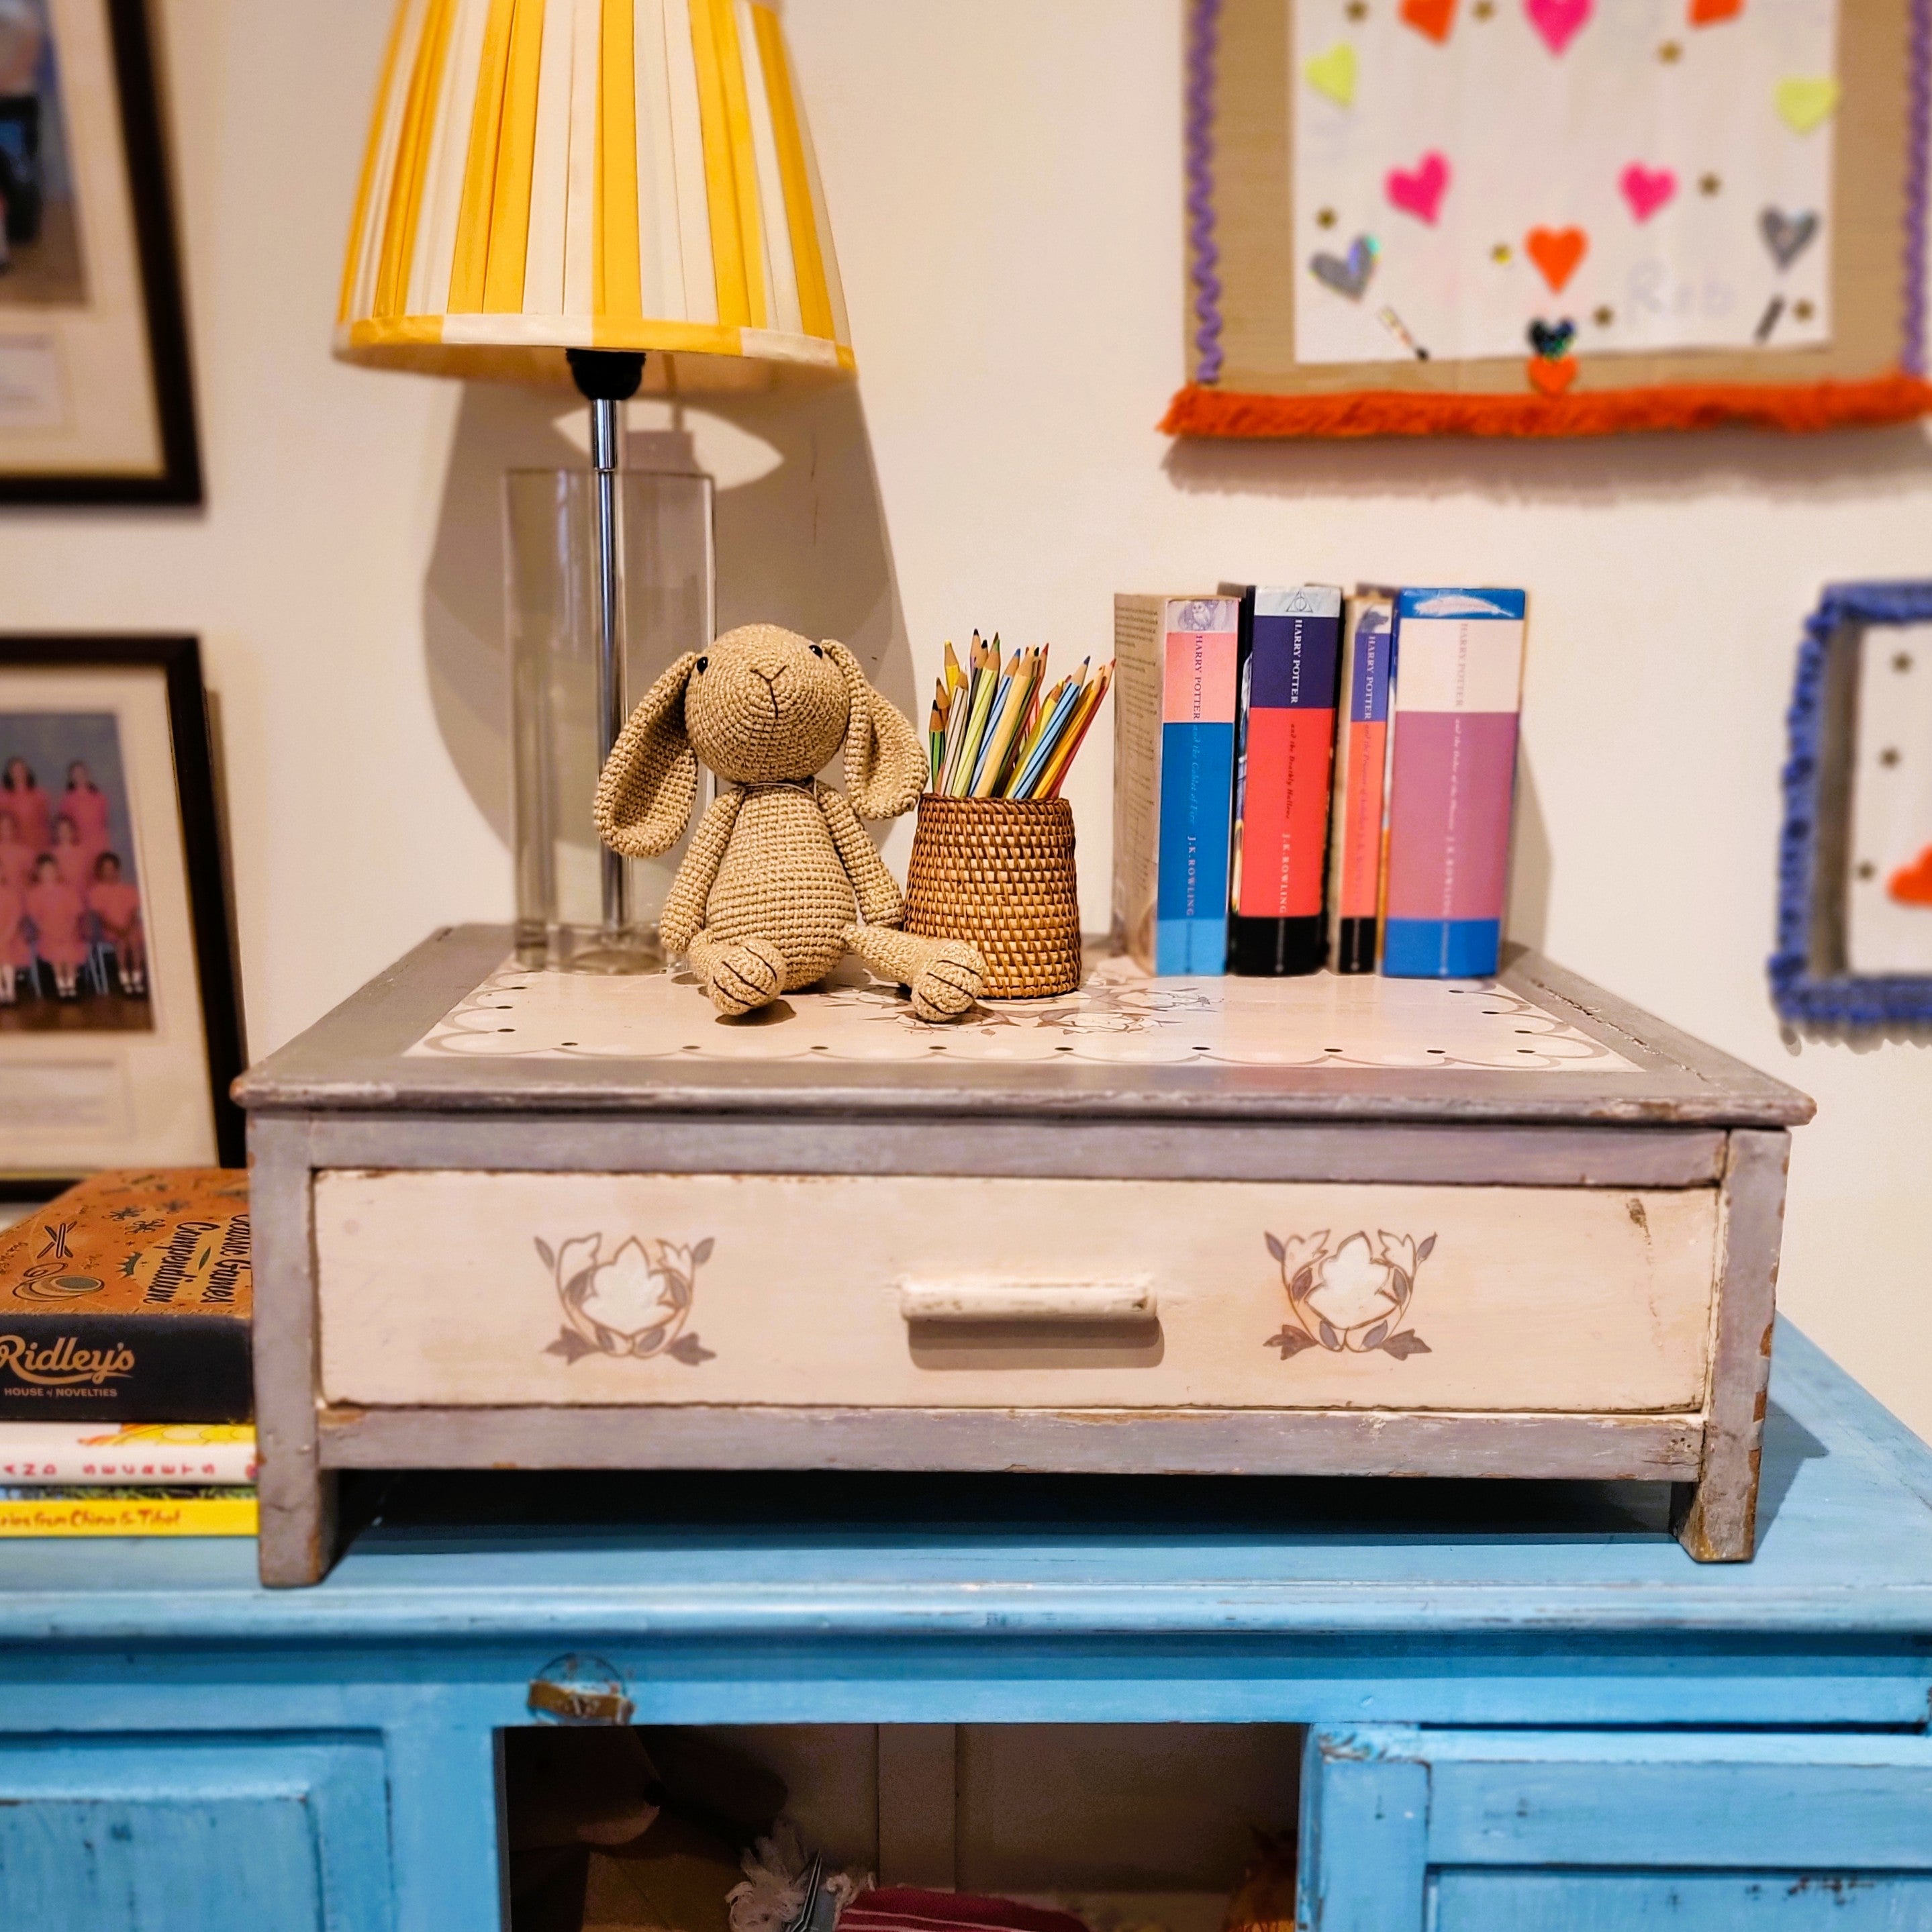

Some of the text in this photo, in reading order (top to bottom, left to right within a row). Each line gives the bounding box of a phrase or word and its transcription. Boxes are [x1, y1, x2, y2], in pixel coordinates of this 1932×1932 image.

[1294, 620, 1302, 657] HARRY
[1367, 636, 1375, 673] HARRY
[1459, 623, 1468, 659] HARRY
[1291, 659, 1300, 704] POTTER
[1365, 677, 1373, 720] POTTER
[1456, 663, 1465, 706] POTTER
[1190, 636, 1203, 824] HARRY POTTER and the Goblet of Fire
[1286, 756, 1295, 785] Deathly
[143, 1222, 220, 1304] Compendium
[200, 1259, 251, 1303] Games
[0, 1335, 134, 1384] Ridley's
[4, 1388, 44, 1396] HOUSE
[56, 1388, 117, 1397] NOVELTIES
[3, 1463, 57, 1476] AND
[36, 1510, 67, 1528] from
[71, 1509, 116, 1527] China
